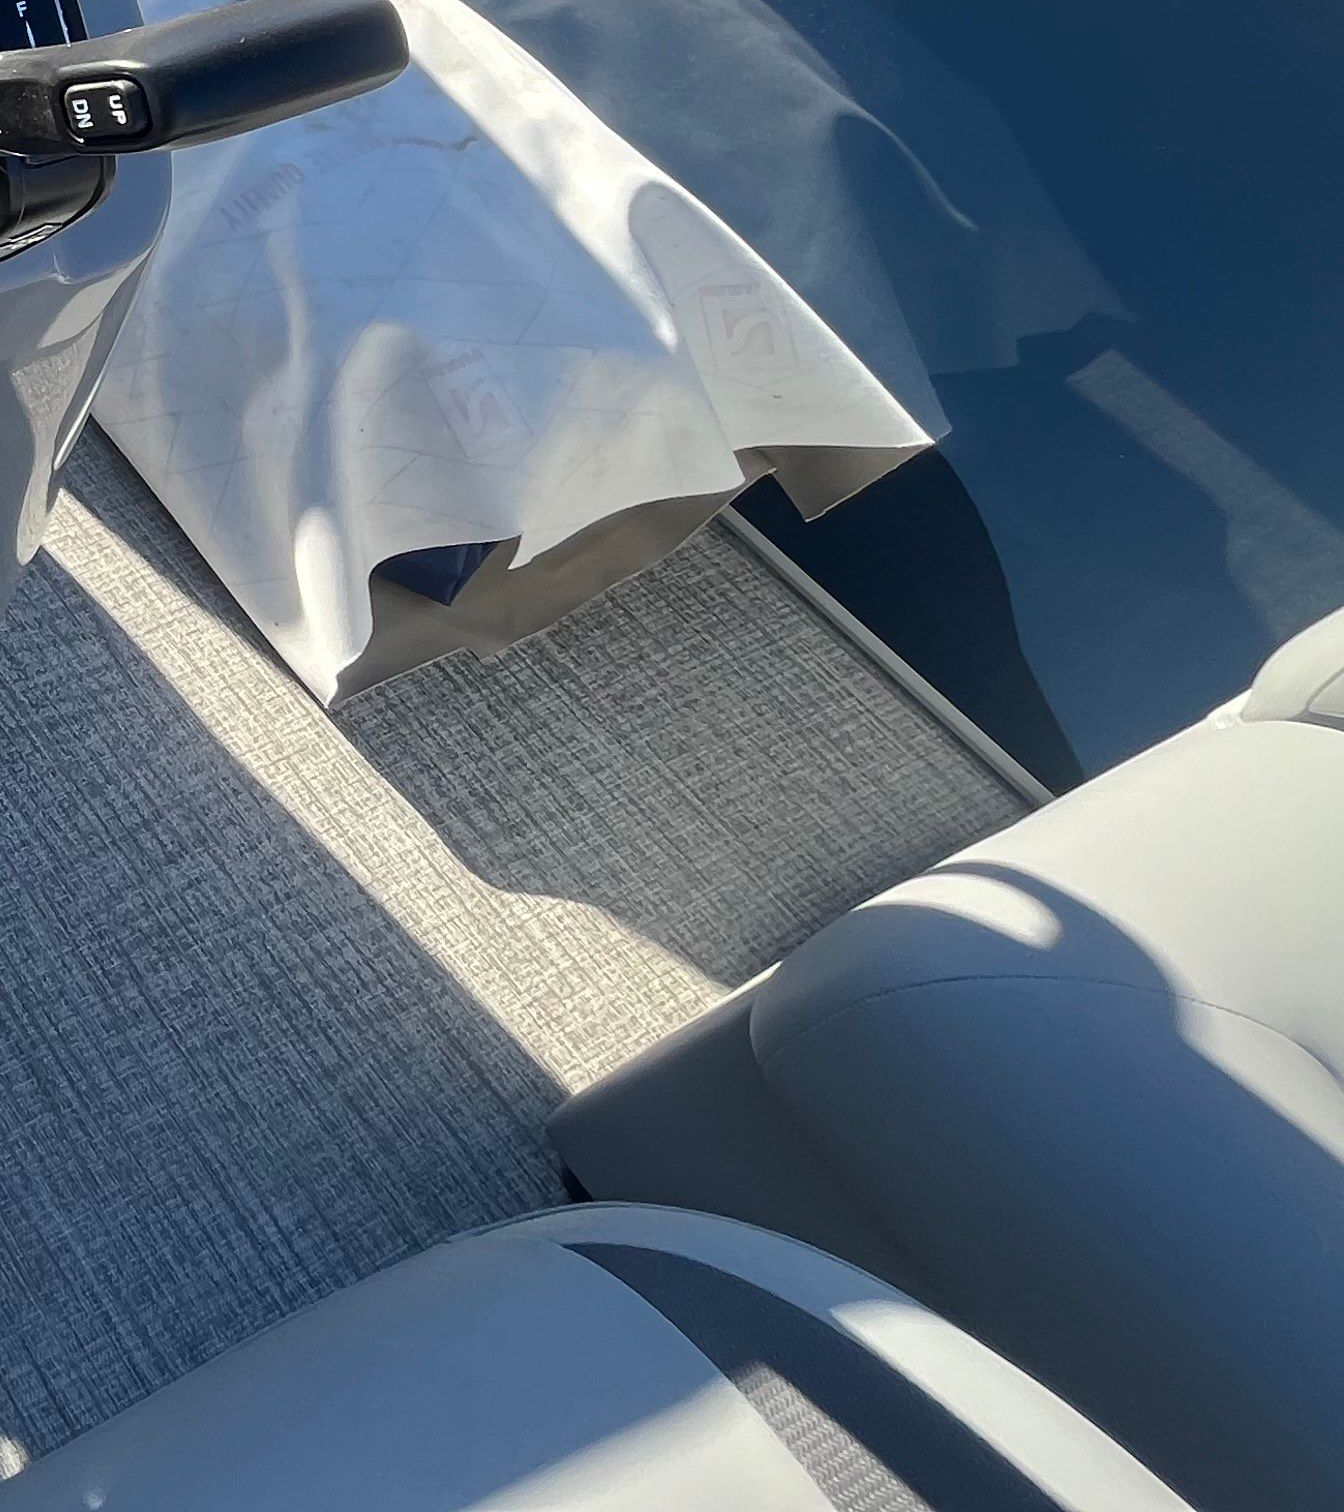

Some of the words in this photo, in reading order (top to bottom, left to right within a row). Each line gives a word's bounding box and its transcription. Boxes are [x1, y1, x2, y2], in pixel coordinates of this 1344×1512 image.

[16, 1, 27, 17] F
[71, 98, 94, 128] DN
[108, 94, 127, 125] UP
